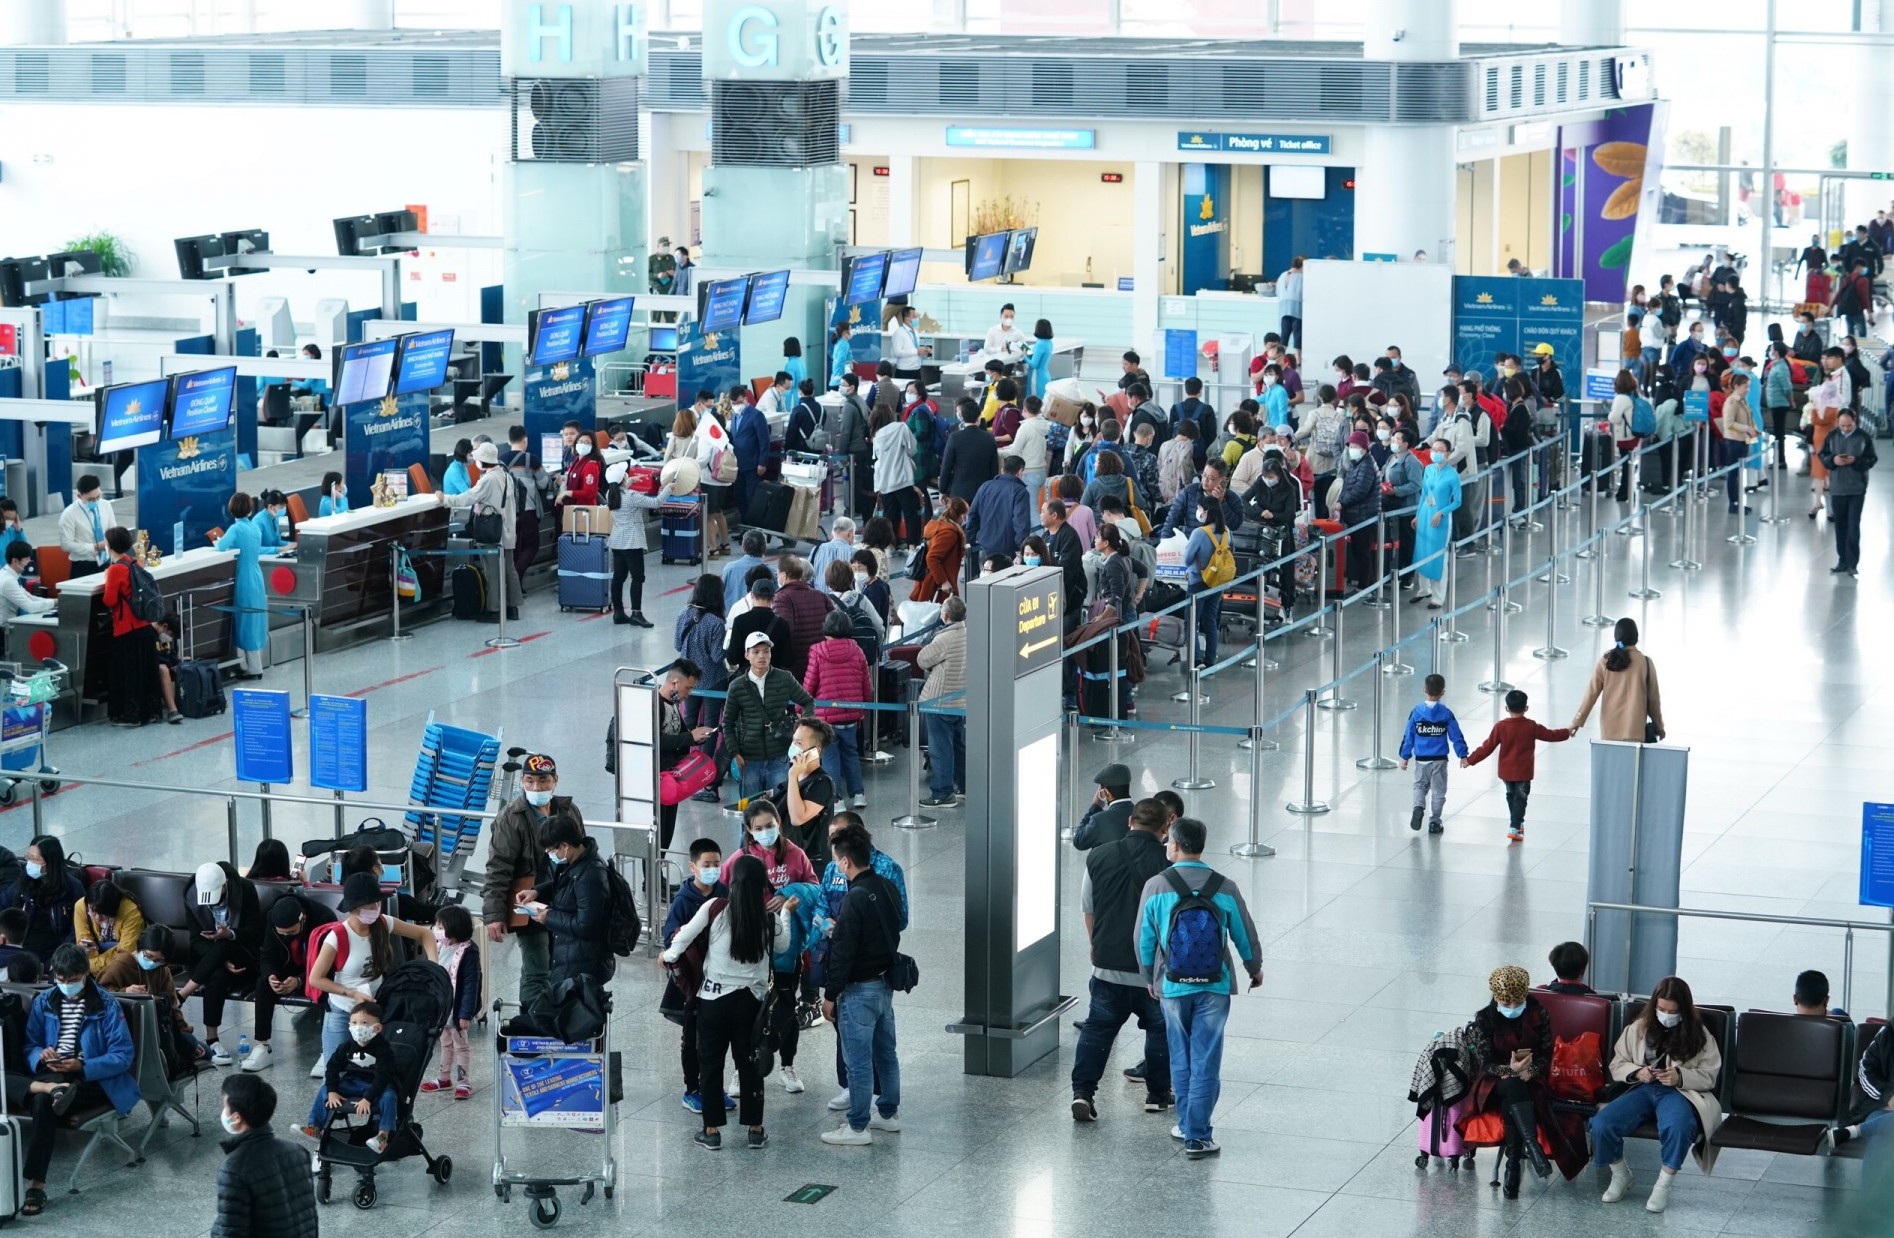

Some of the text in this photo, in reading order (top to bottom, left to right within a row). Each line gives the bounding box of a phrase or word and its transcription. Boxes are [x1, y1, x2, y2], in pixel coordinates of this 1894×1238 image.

[529, 4, 572, 61] H
[615, 4, 638, 60] H
[727, 4, 779, 67] G
[815, 6, 842, 66] G
[1229, 136, 1273, 150] Phòng vé
[1279, 139, 1322, 150] Ticket office
[1019, 614, 1046, 634] Departure
